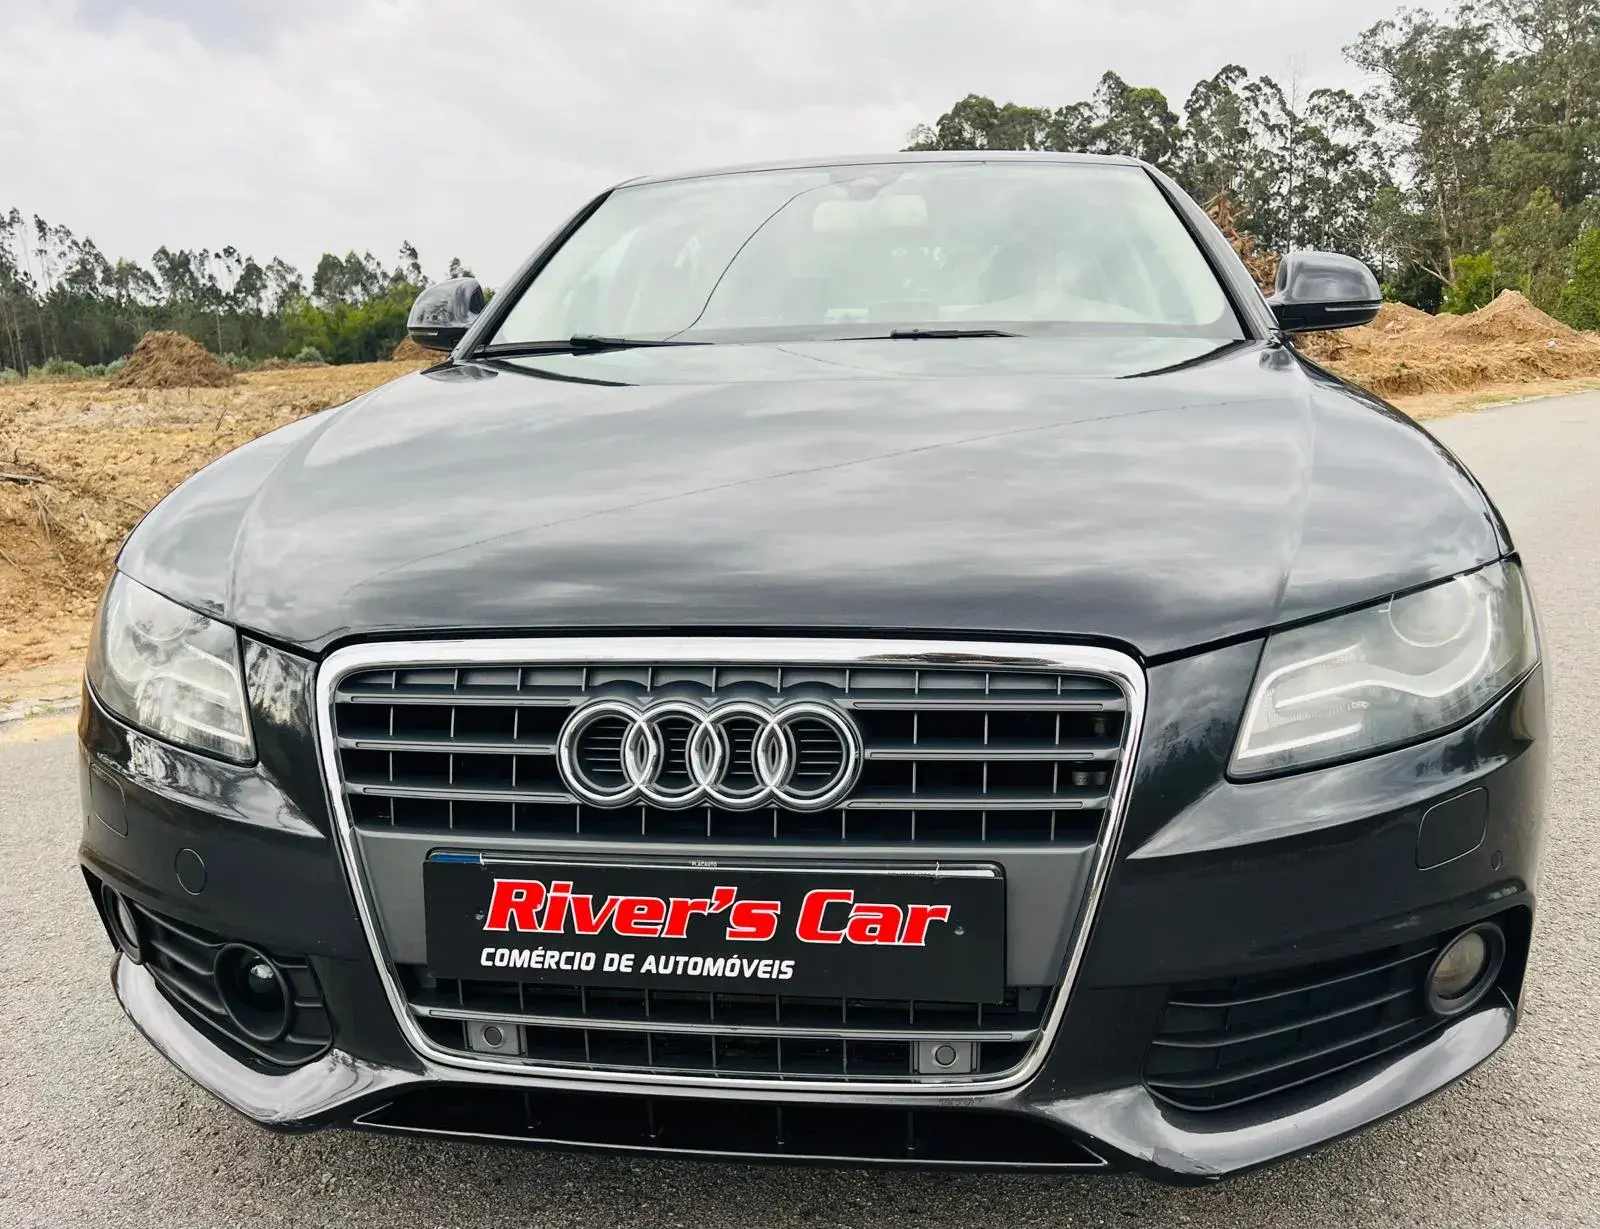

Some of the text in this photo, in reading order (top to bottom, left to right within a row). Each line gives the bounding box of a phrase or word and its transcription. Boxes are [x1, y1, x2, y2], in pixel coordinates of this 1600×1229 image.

[483, 879, 951, 946] River's Car
[480, 946, 795, 980] COMÉRCIO DE AUTOMÓVEIS
